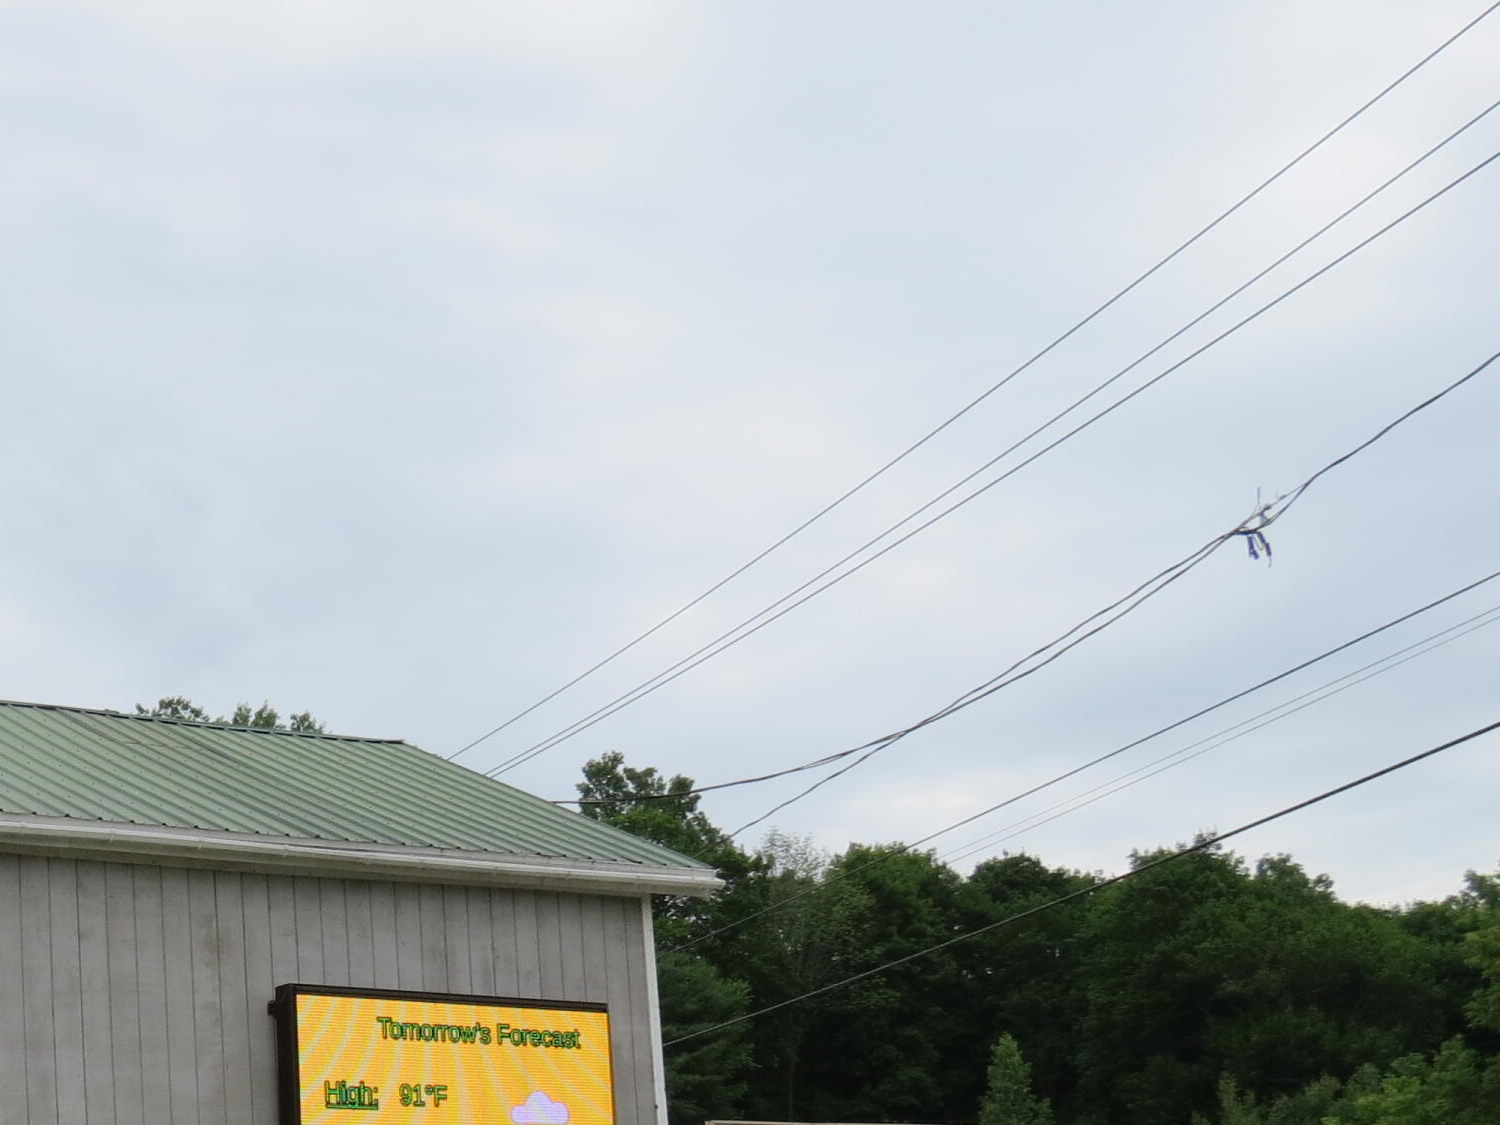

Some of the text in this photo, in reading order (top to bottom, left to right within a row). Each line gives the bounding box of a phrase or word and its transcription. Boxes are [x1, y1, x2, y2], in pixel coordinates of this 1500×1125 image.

[376, 1016, 581, 1048] Tomorrow's Forecast
[324, 1080, 378, 1110] High:
